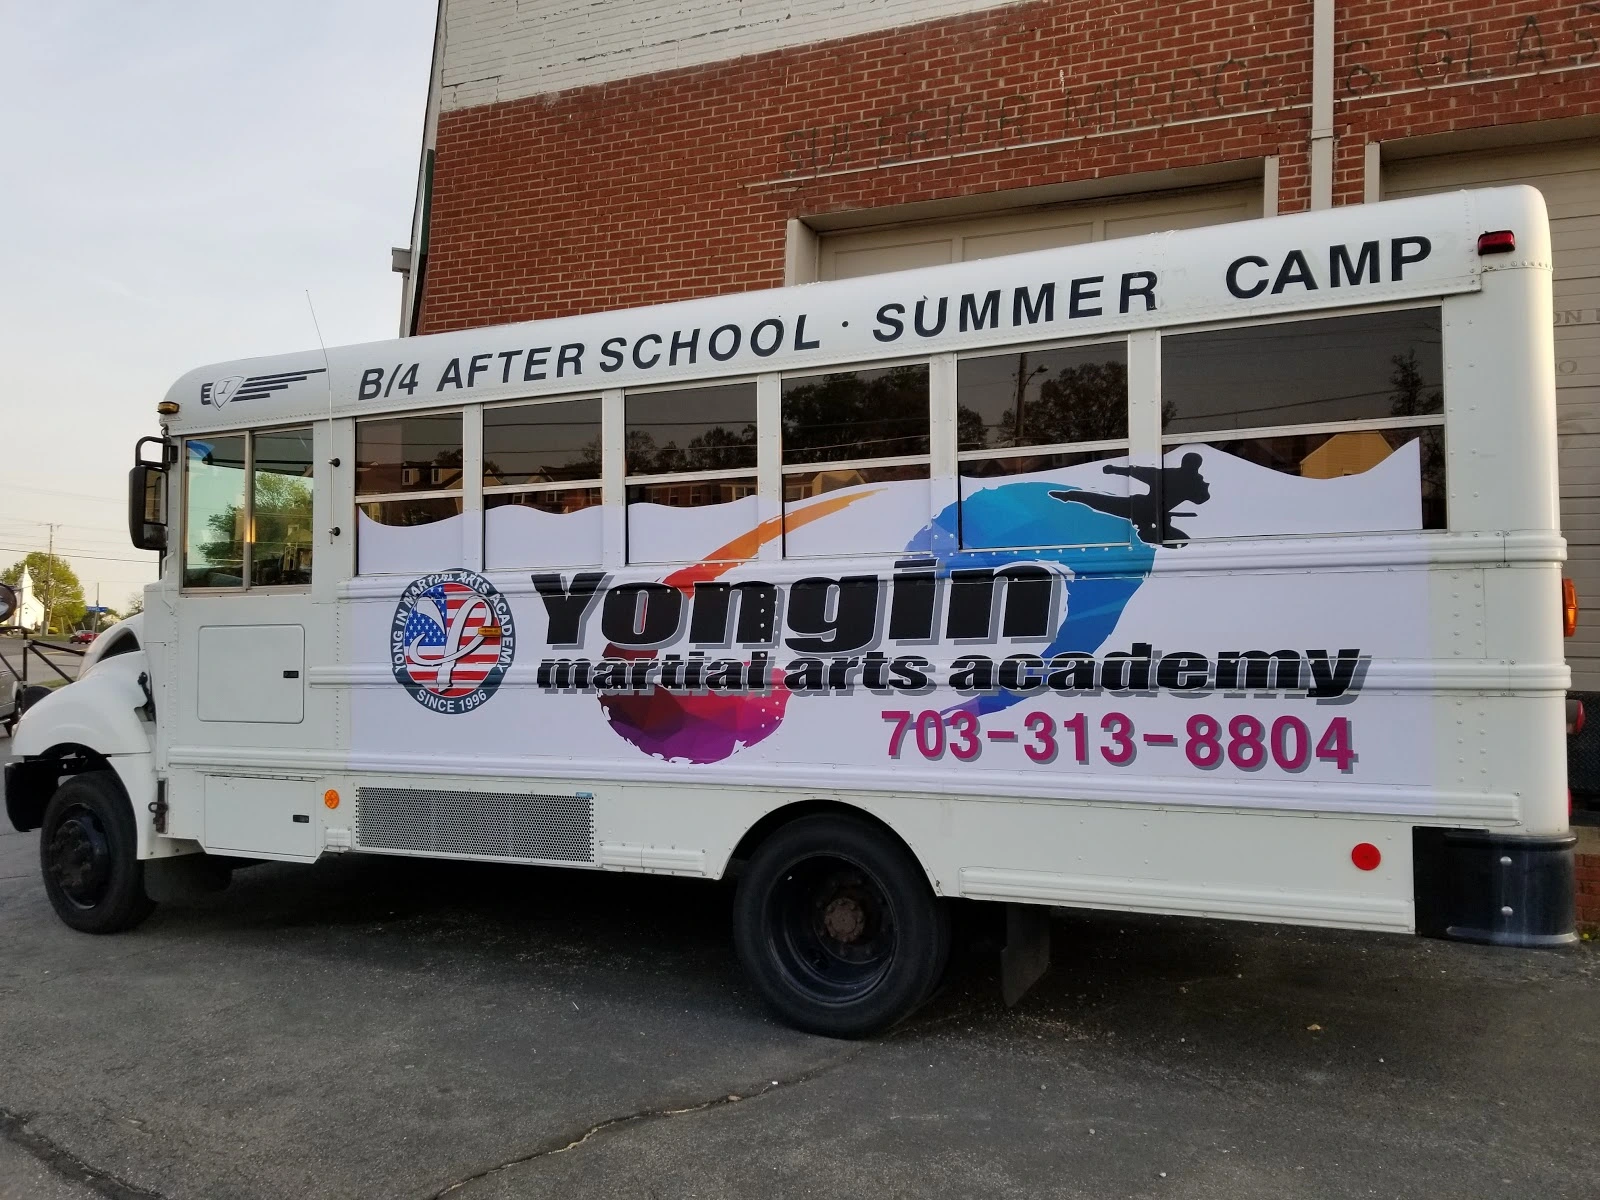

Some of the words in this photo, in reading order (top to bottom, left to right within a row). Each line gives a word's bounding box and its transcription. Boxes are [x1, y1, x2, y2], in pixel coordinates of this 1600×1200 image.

[358, 363, 419, 400] B/4
[436, 342, 585, 392] AFTER
[600, 314, 820, 372] SCHOOL
[873, 270, 1158, 342] SUMMER
[1225, 236, 1432, 298] CAMP
[456, 572, 490, 595] ARTS
[489, 594, 513, 674] ACADEMY
[531, 559, 1060, 655] Yongin
[417, 689, 455, 712] SINCE
[459, 689, 487, 711] 1996
[537, 651, 774, 696] martial
[784, 651, 936, 696] arts
[949, 642, 1366, 702] academy
[881, 710, 1358, 773] 703-313-8804
